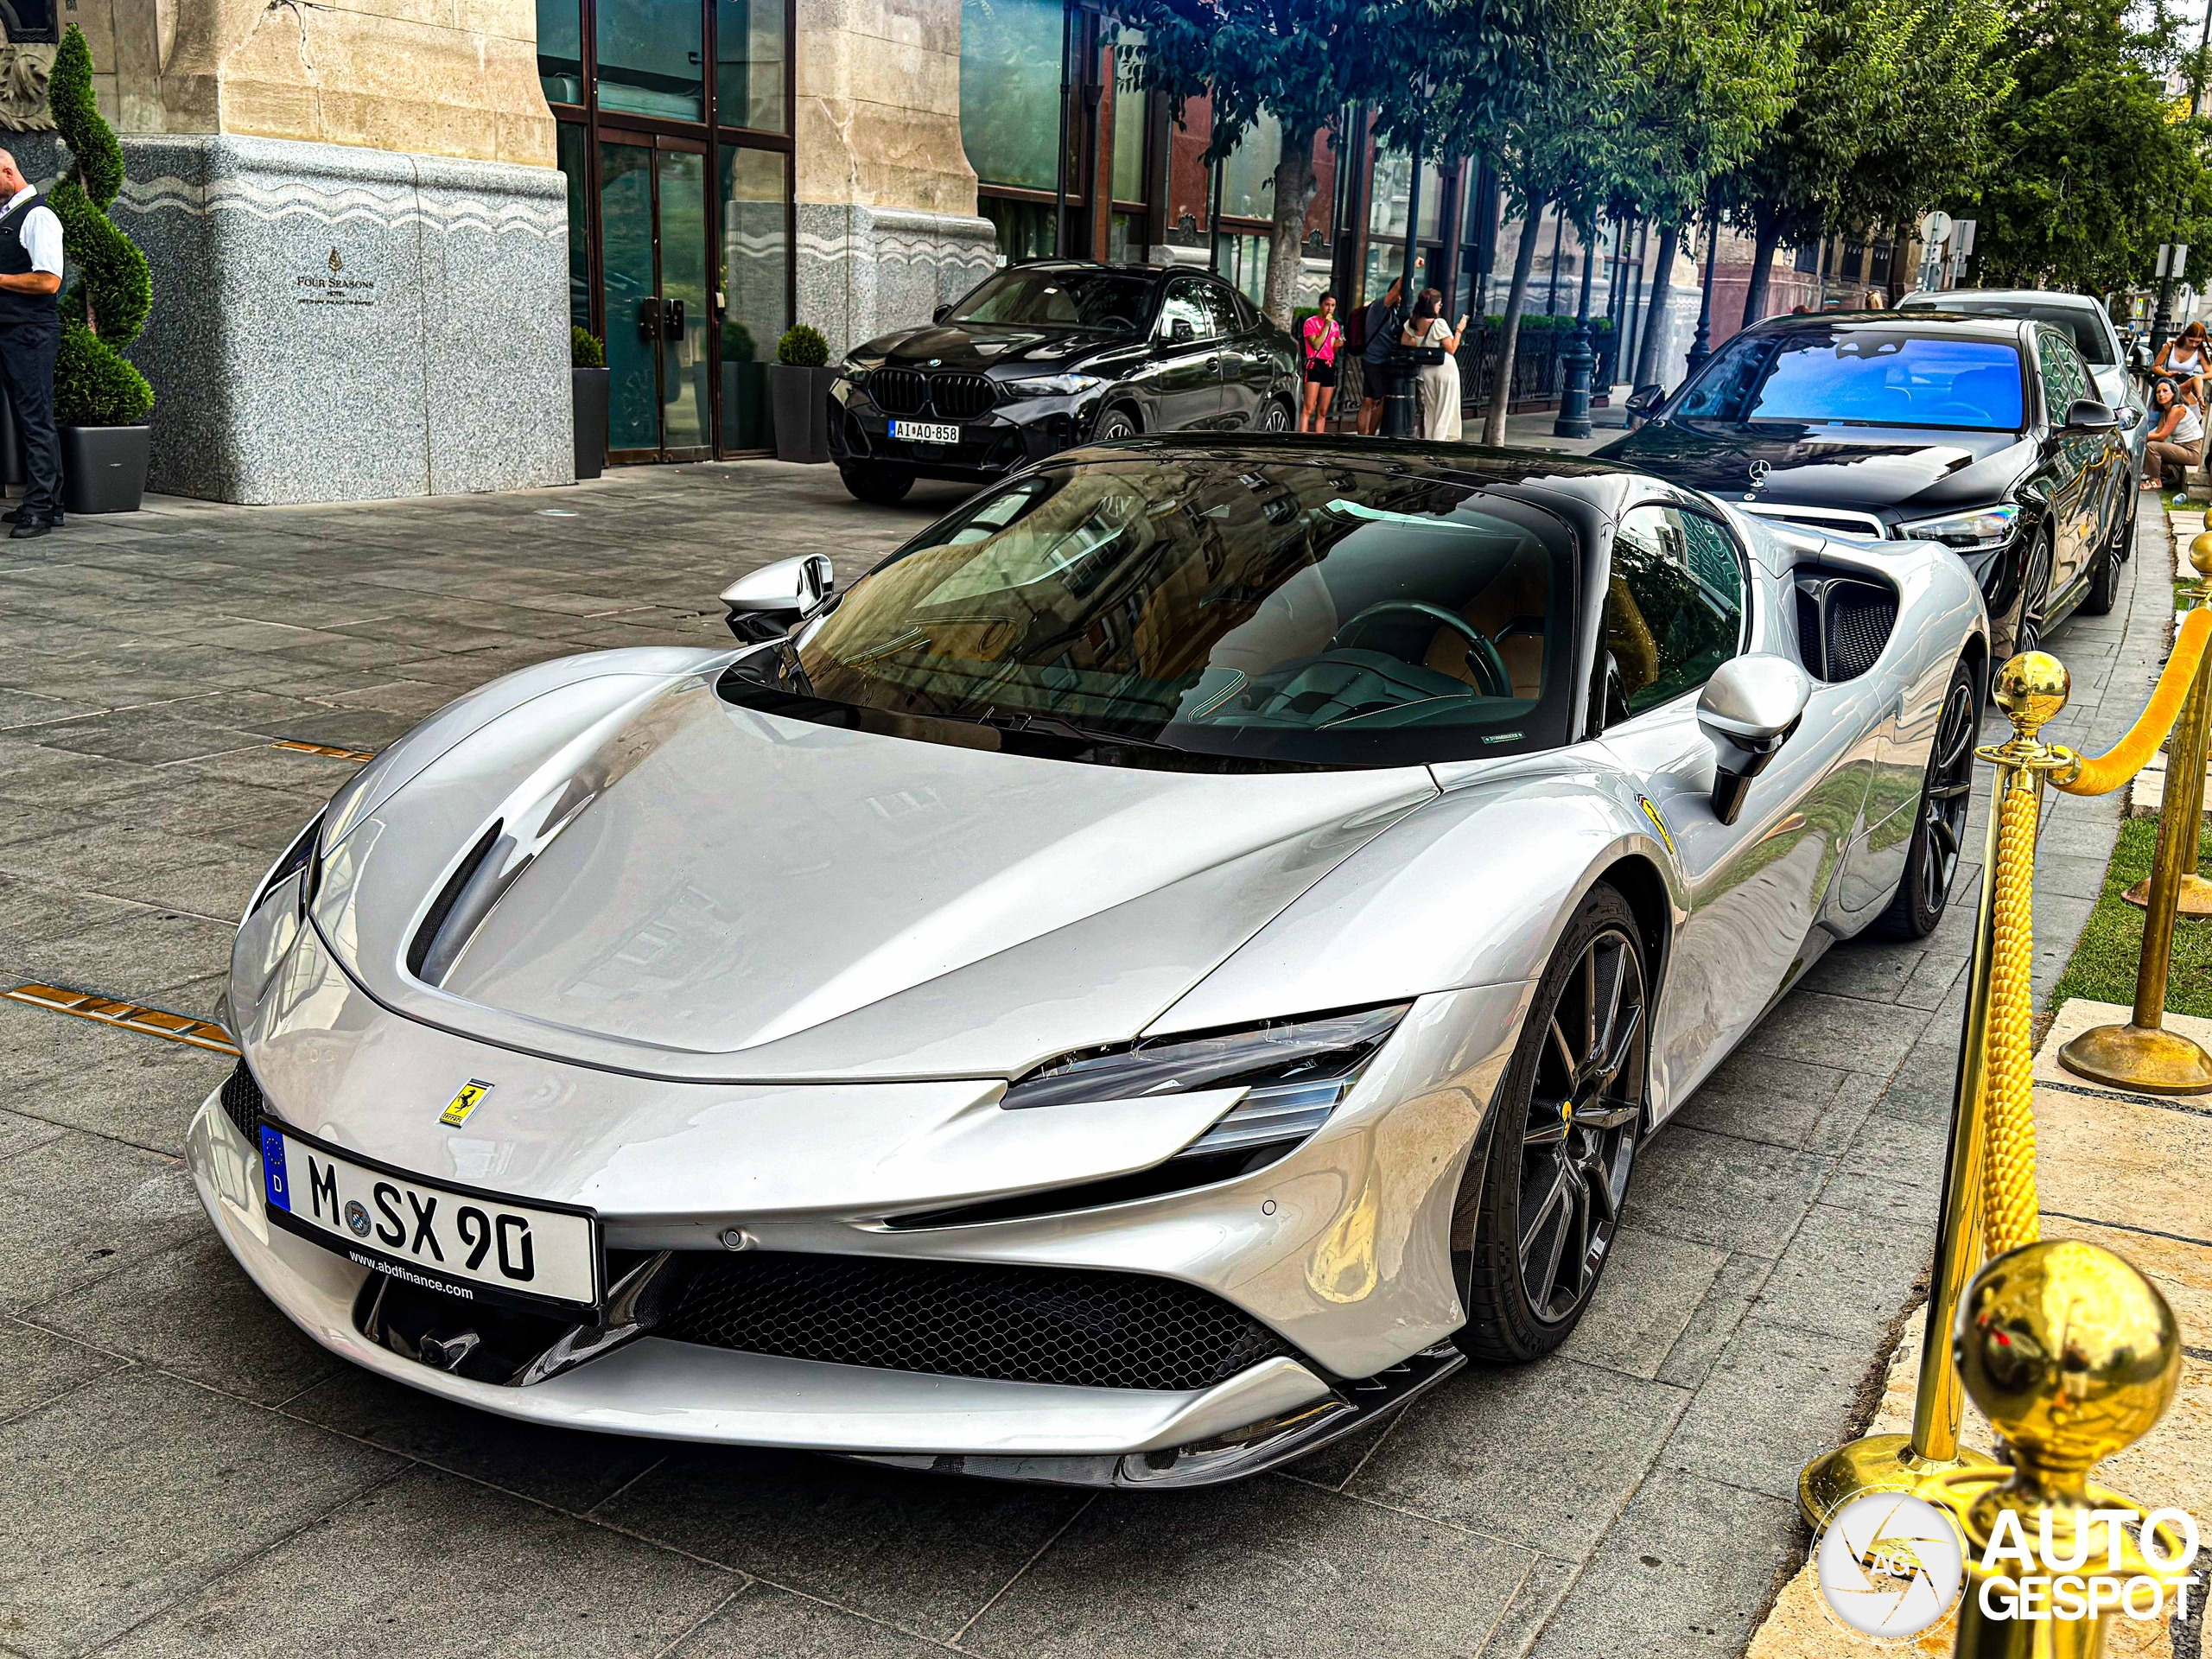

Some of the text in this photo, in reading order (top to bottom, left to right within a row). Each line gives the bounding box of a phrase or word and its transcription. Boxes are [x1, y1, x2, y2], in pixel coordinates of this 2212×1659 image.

[297, 276, 374, 289] FOUR SEASONS
[273, 1174, 283, 1192] D
[308, 1154, 341, 1227] M
[373, 1181, 445, 1262] SX
[457, 1205, 535, 1282] 90
[349, 1250, 474, 1300] www.abdfinance.com
